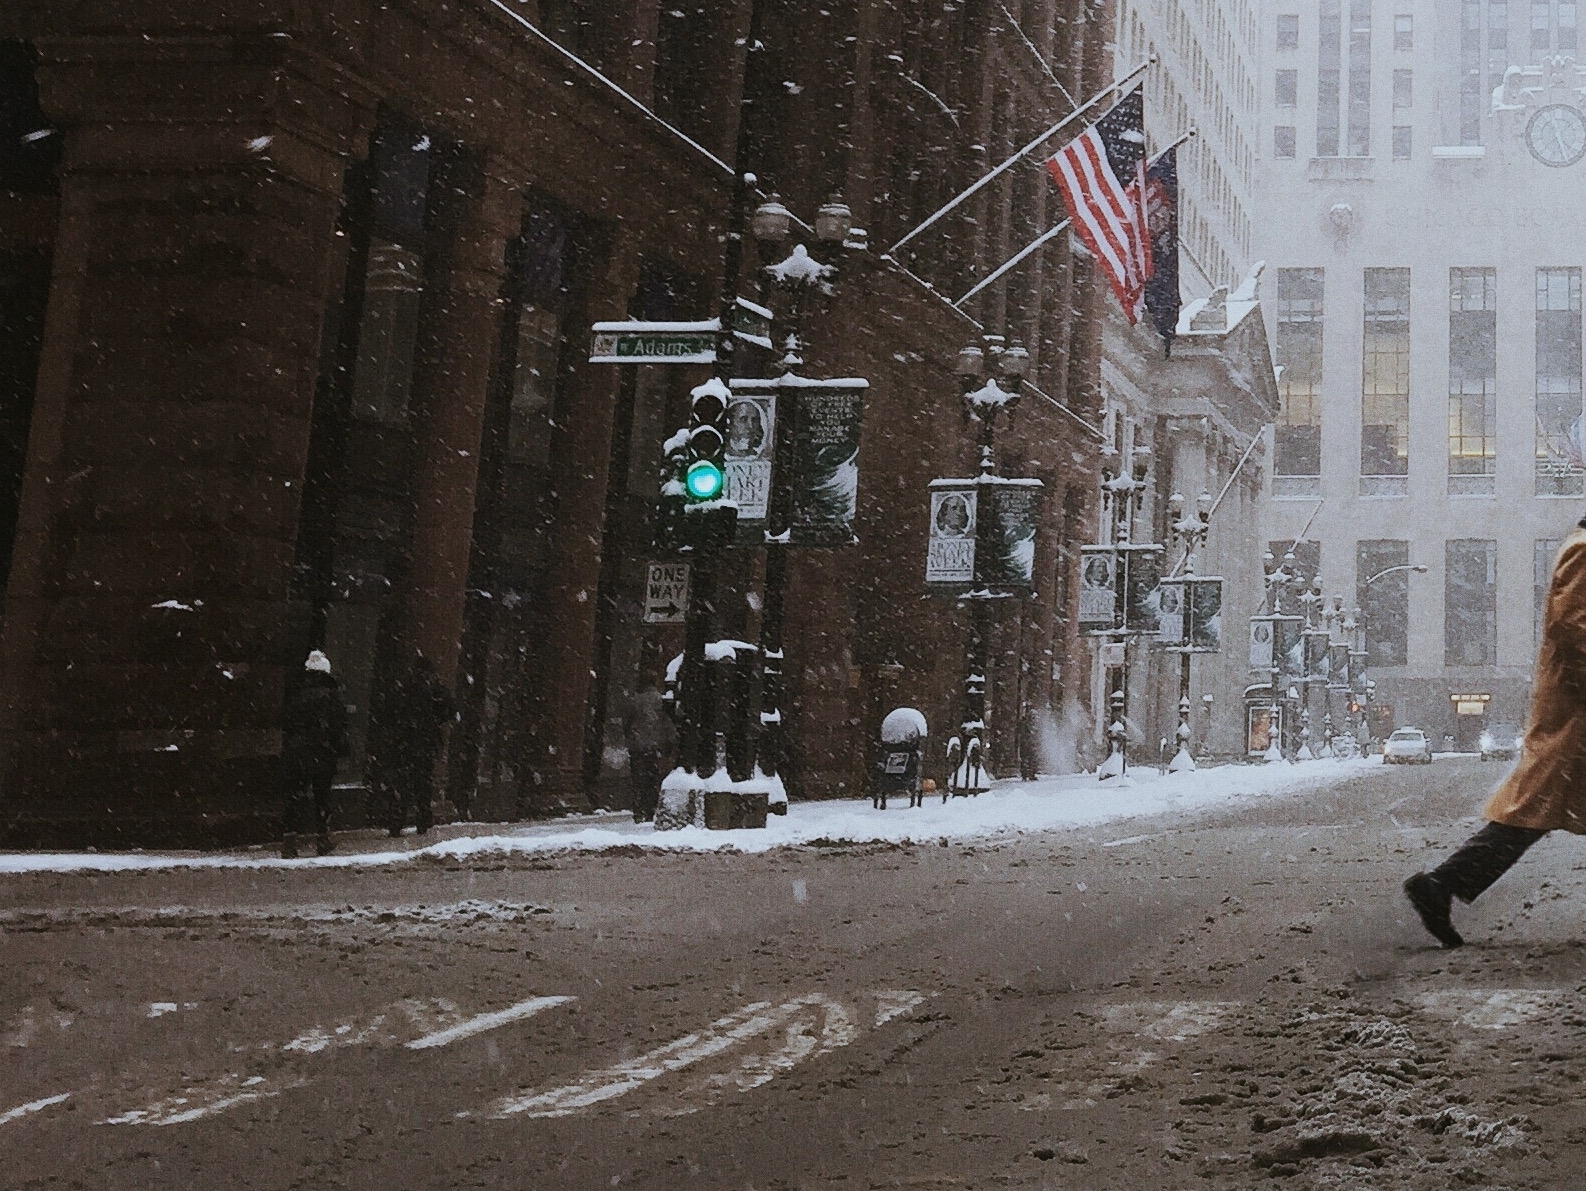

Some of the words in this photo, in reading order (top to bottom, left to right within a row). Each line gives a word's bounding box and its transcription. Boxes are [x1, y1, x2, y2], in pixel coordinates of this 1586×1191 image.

[633, 339, 692, 355] Adams
[930, 558, 971, 569] WEEK
[652, 568, 685, 582] ONE
[650, 584, 685, 599] WAY
